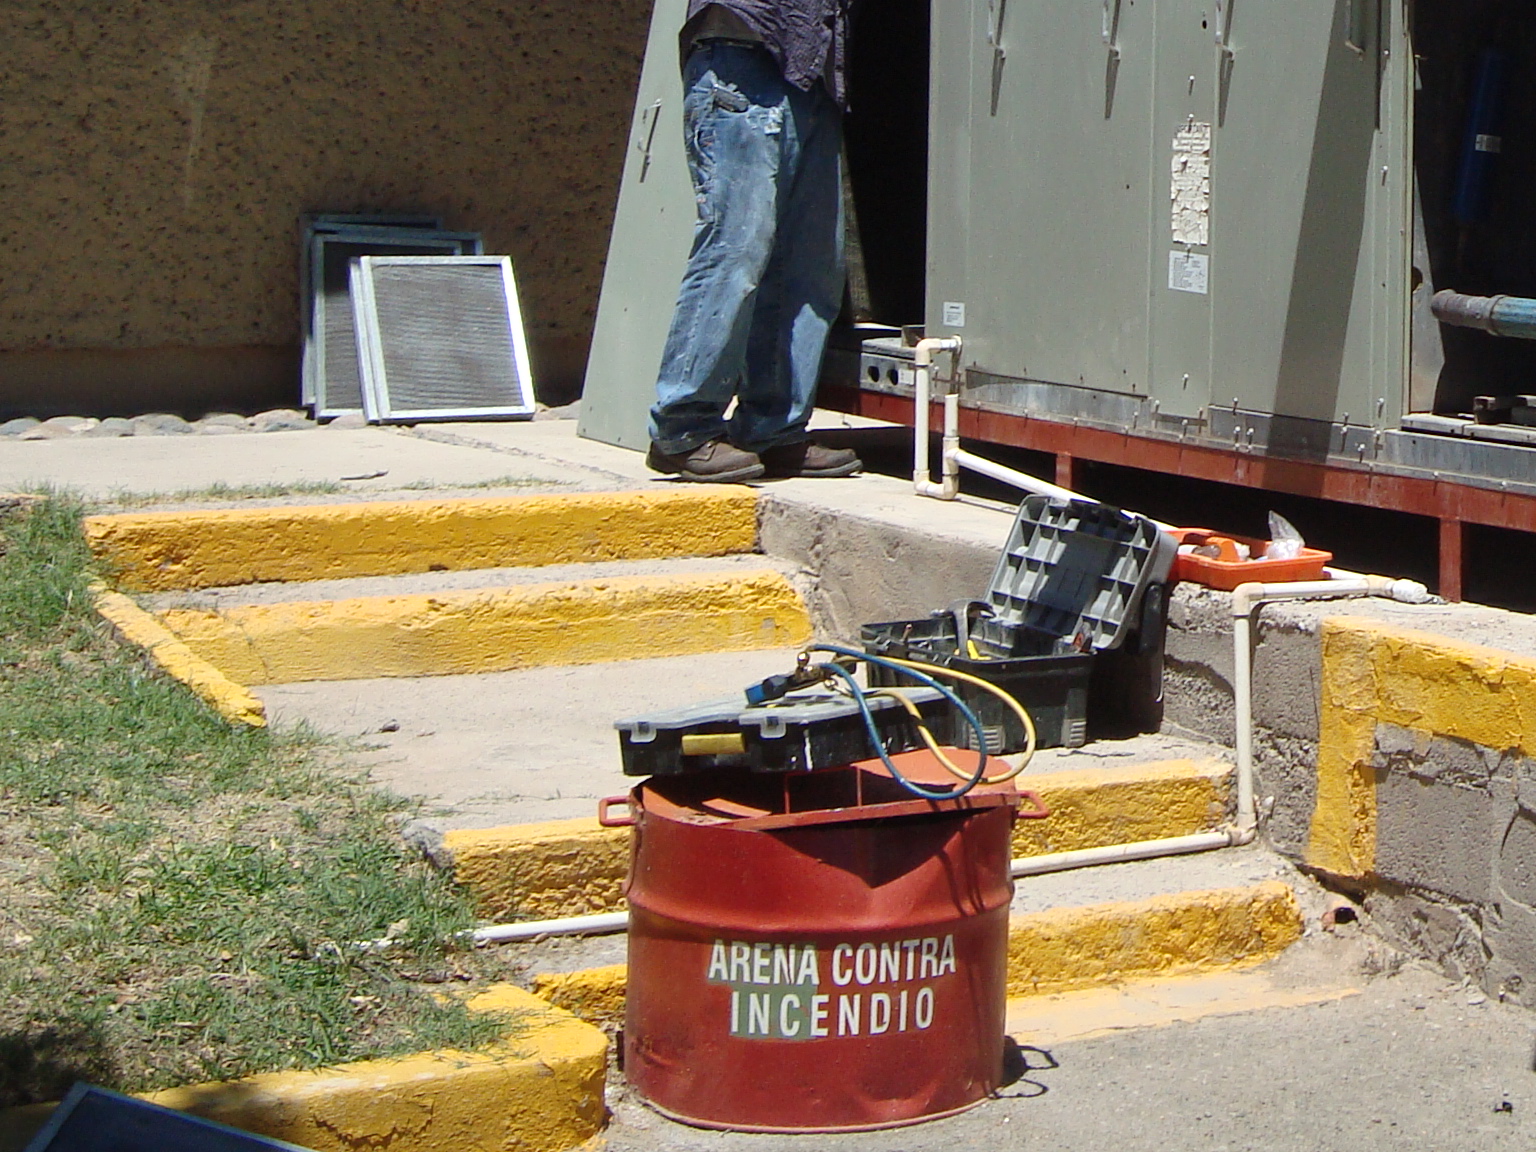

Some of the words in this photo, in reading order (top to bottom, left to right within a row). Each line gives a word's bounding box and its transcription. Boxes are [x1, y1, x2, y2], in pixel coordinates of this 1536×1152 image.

[708, 939, 820, 986] ARENA
[831, 934, 956, 986] CONTRA
[730, 986, 935, 1037] INCENDIO
